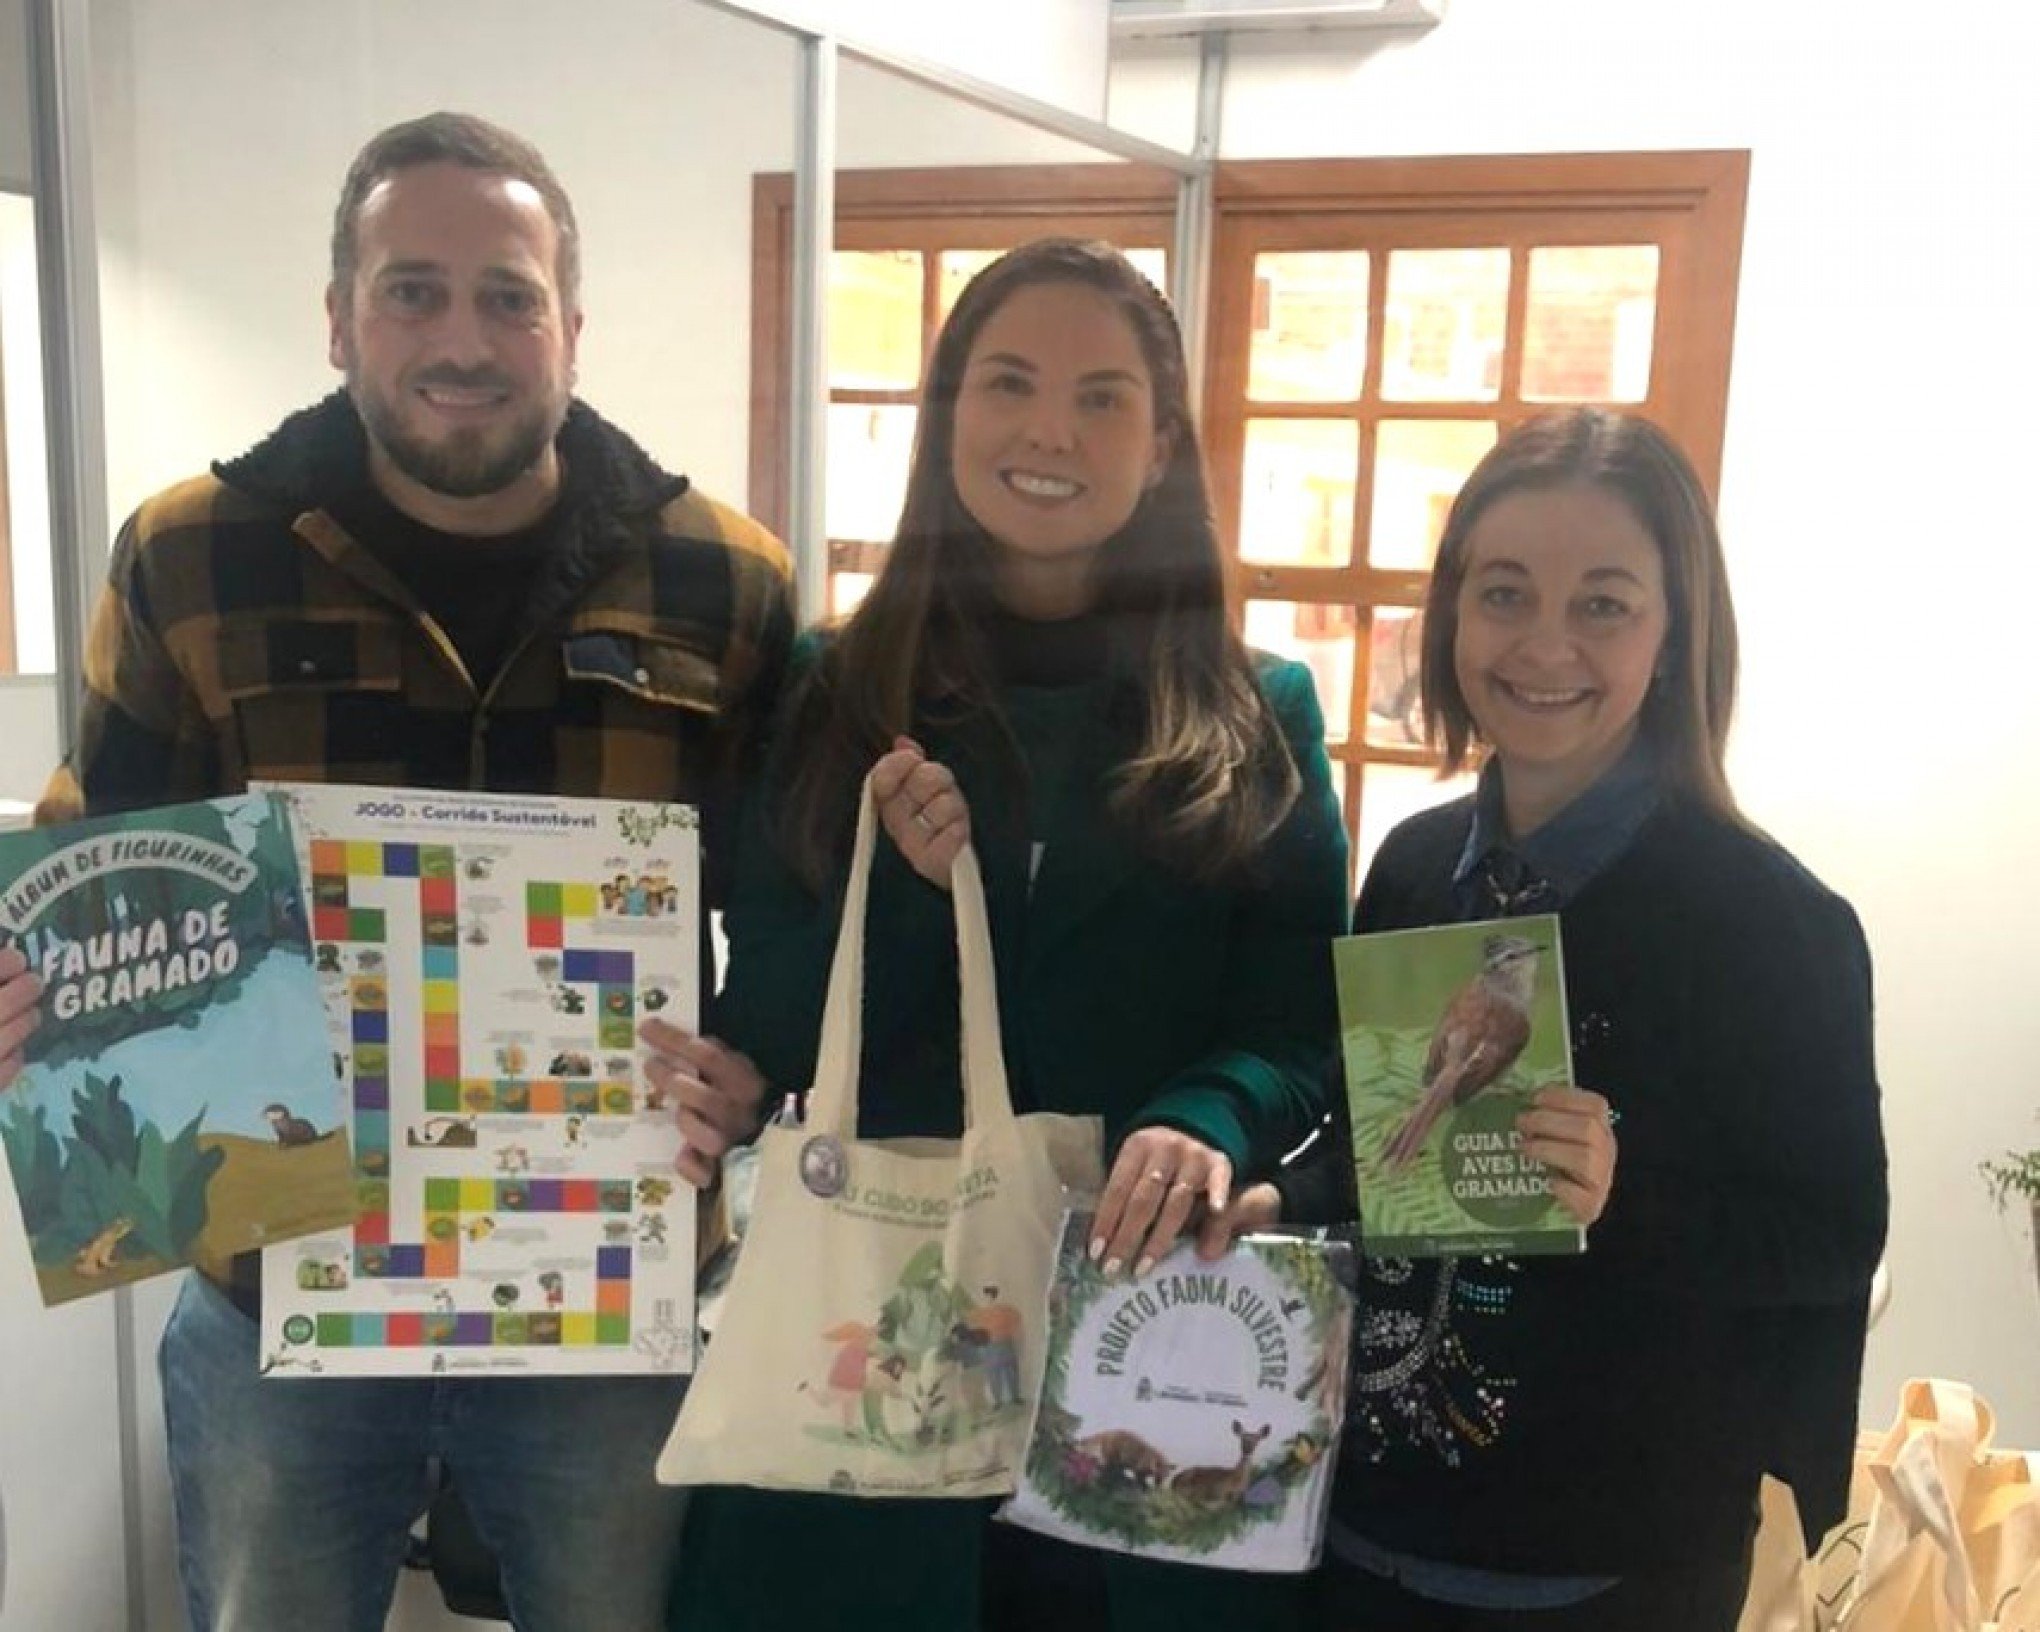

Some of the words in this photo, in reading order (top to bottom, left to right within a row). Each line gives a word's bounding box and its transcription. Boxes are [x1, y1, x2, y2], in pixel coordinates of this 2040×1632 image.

[356, 803, 405, 817] JOGO
[75, 846, 103, 873] DE
[111, 838, 250, 885] FIGURINHAS
[42, 917, 168, 982] FAUNA
[182, 900, 230, 946] DE
[54, 938, 240, 1020] GRAMADO
[1453, 1132, 1503, 1151] GUIA
[1461, 1154, 1515, 1176] AVES
[1096, 1289, 1159, 1376] PROJETO
[1154, 1273, 1229, 1310] FAUNA
[1228, 1285, 1289, 1392] SILVESTRE
